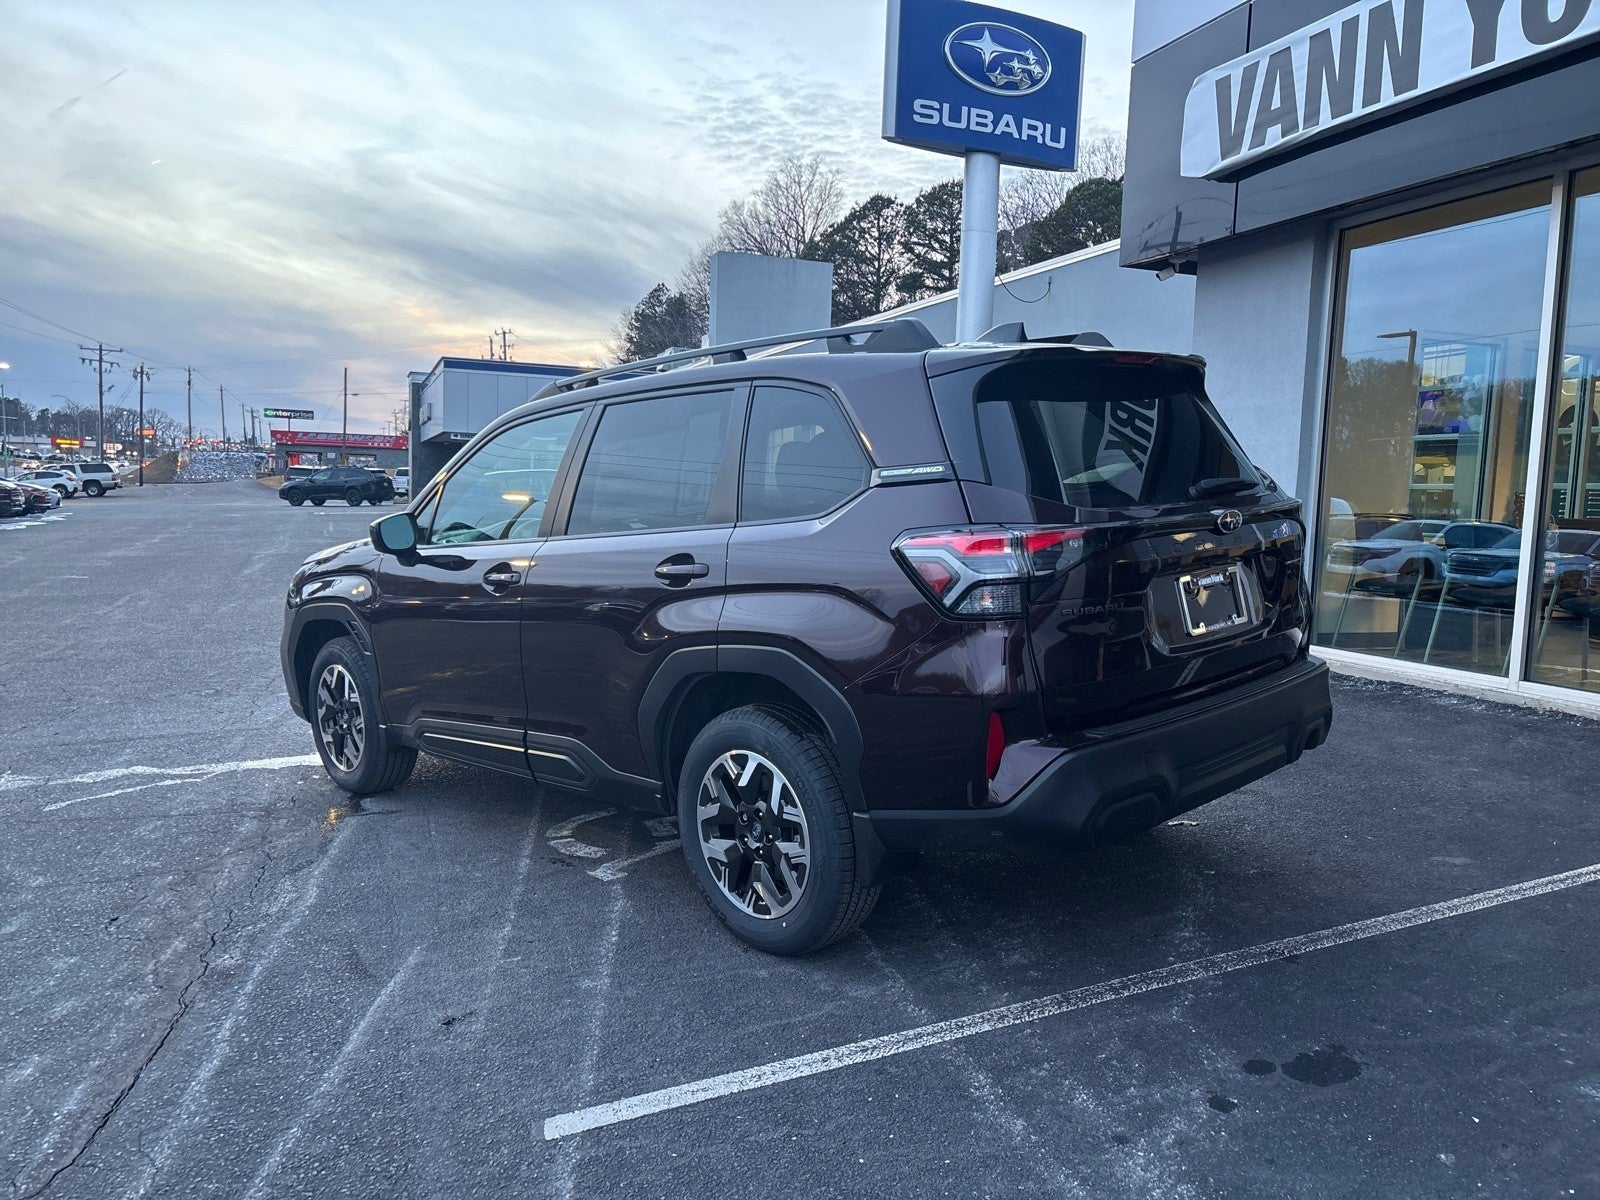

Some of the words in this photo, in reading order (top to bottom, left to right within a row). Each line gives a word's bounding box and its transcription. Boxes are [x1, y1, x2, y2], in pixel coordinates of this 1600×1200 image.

[1215, 0, 1426, 162] VANN
[912, 98, 1066, 149] SUBARU
[265, 409, 313, 418] enterprise
[911, 465, 943, 474] AWD
[1061, 603, 1123, 616] SUBARU
